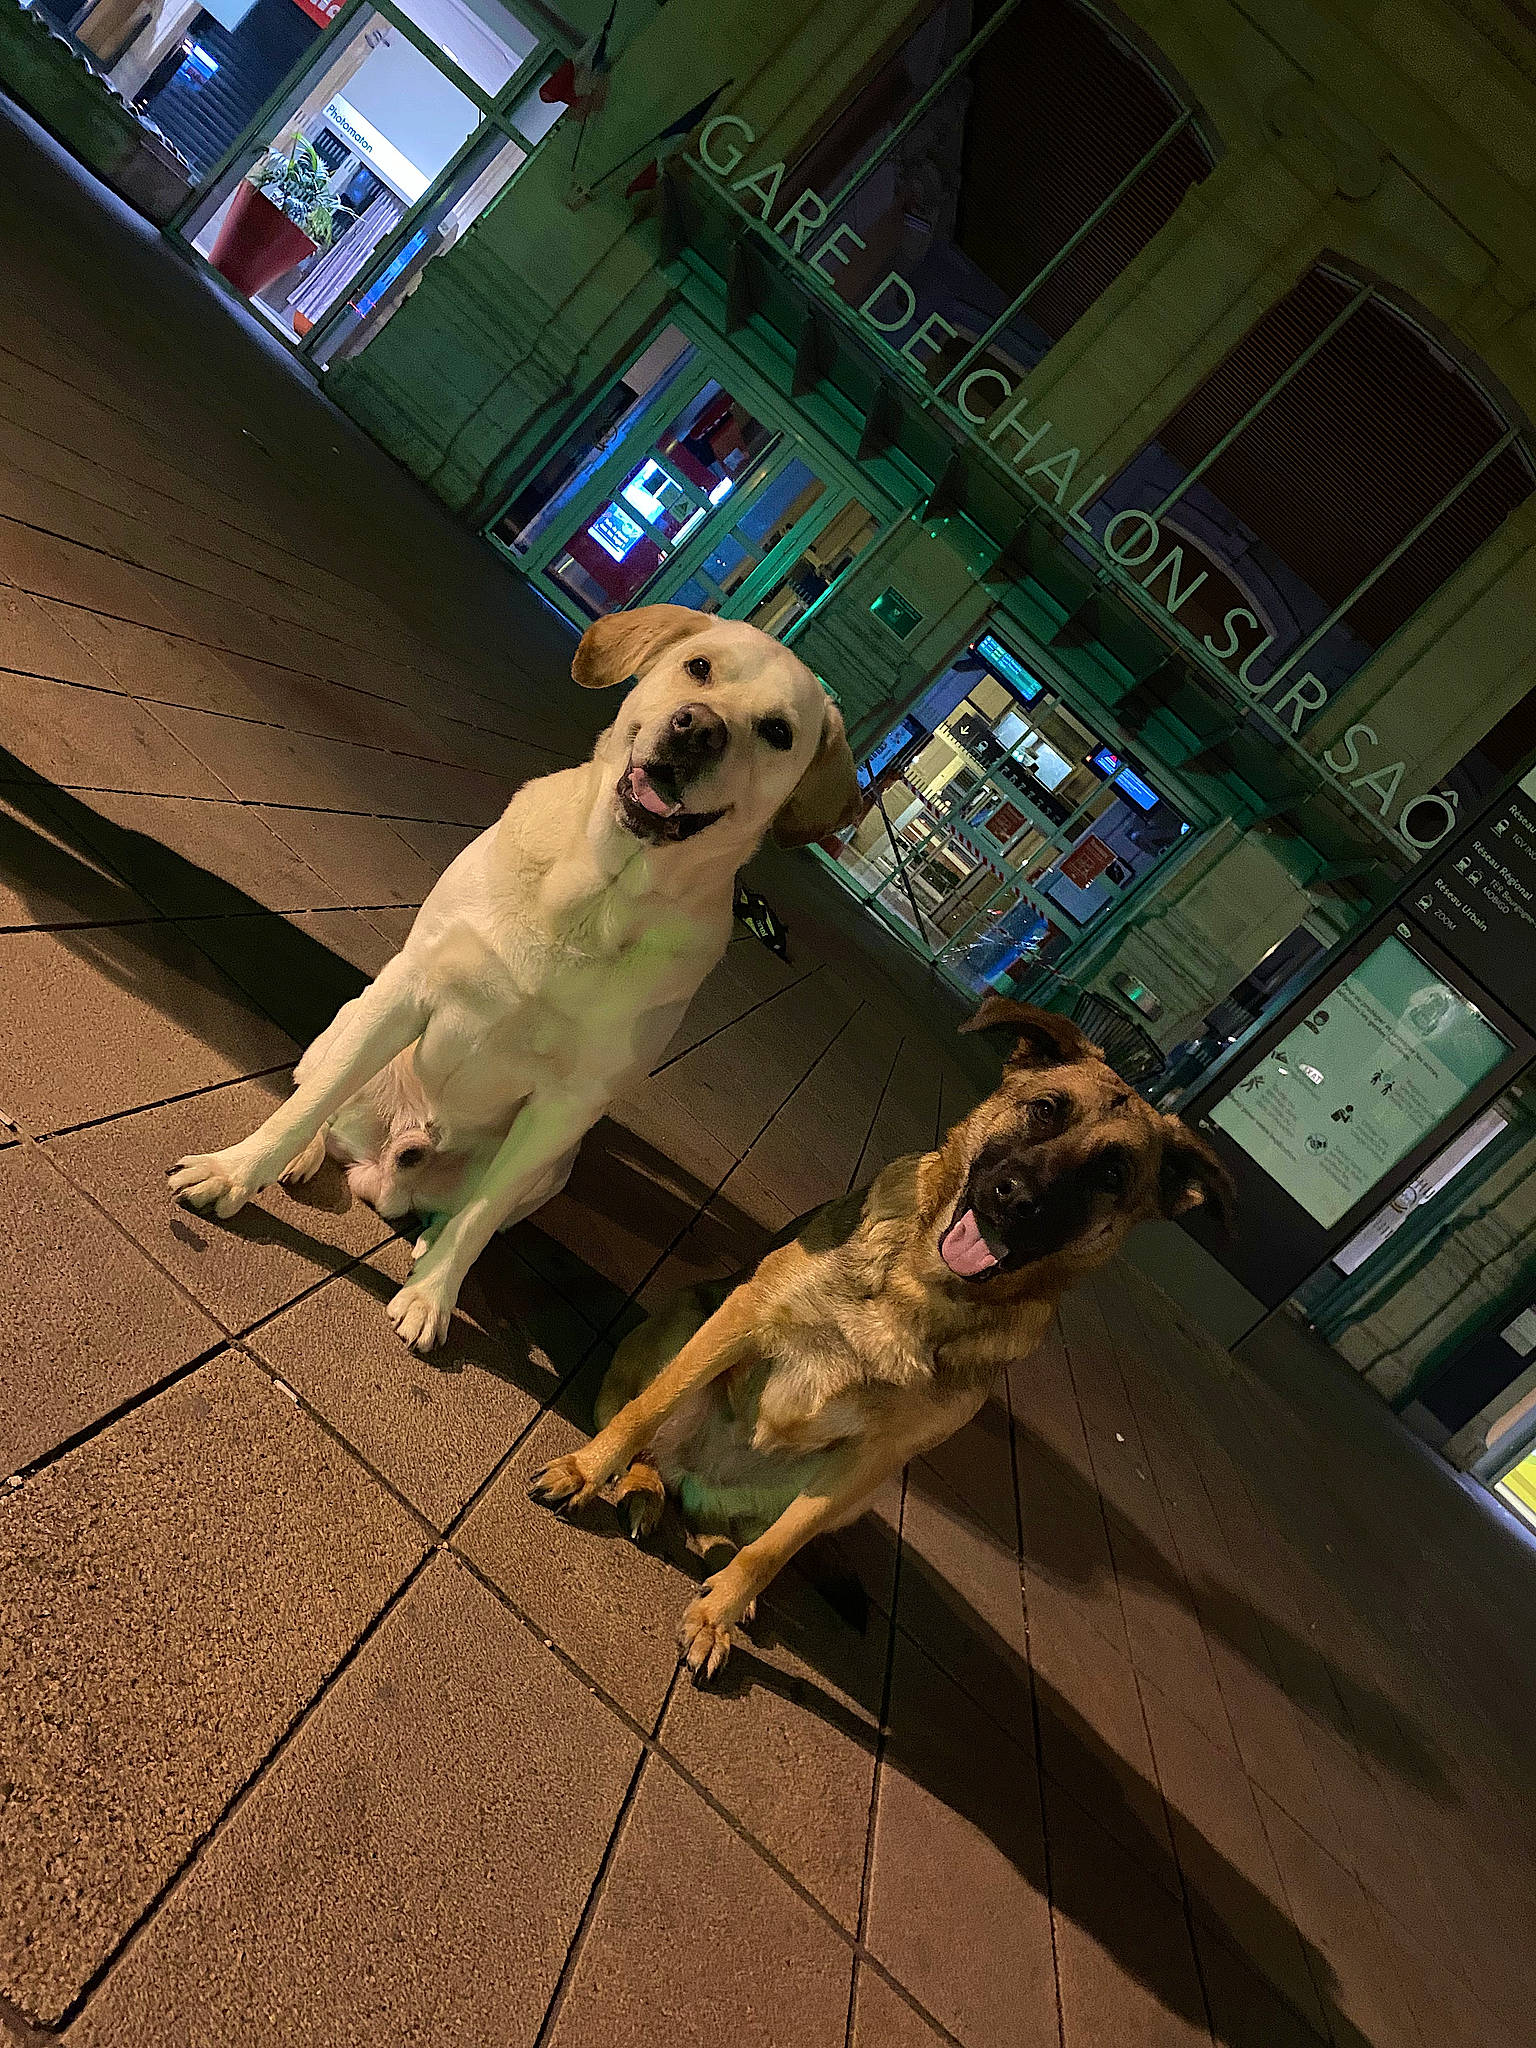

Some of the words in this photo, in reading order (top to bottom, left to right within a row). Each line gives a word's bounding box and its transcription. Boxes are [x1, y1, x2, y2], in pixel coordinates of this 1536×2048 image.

[325, 103, 373, 153] Photomaton
[699, 114, 866, 286] GARE
[858, 271, 958, 373] DE
[956, 367, 1209, 614] CHALON
[1203, 607, 1329, 734] SUR
[1472, 840, 1500, 870] Réseau
[1498, 866, 1534, 902] Régional
[1433, 908, 1457, 931] ZOOM
[1434, 878, 1462, 908] Réseau
[1461, 904, 1488, 932] Urbain
[1482, 886, 1510, 914] MOBIGO
